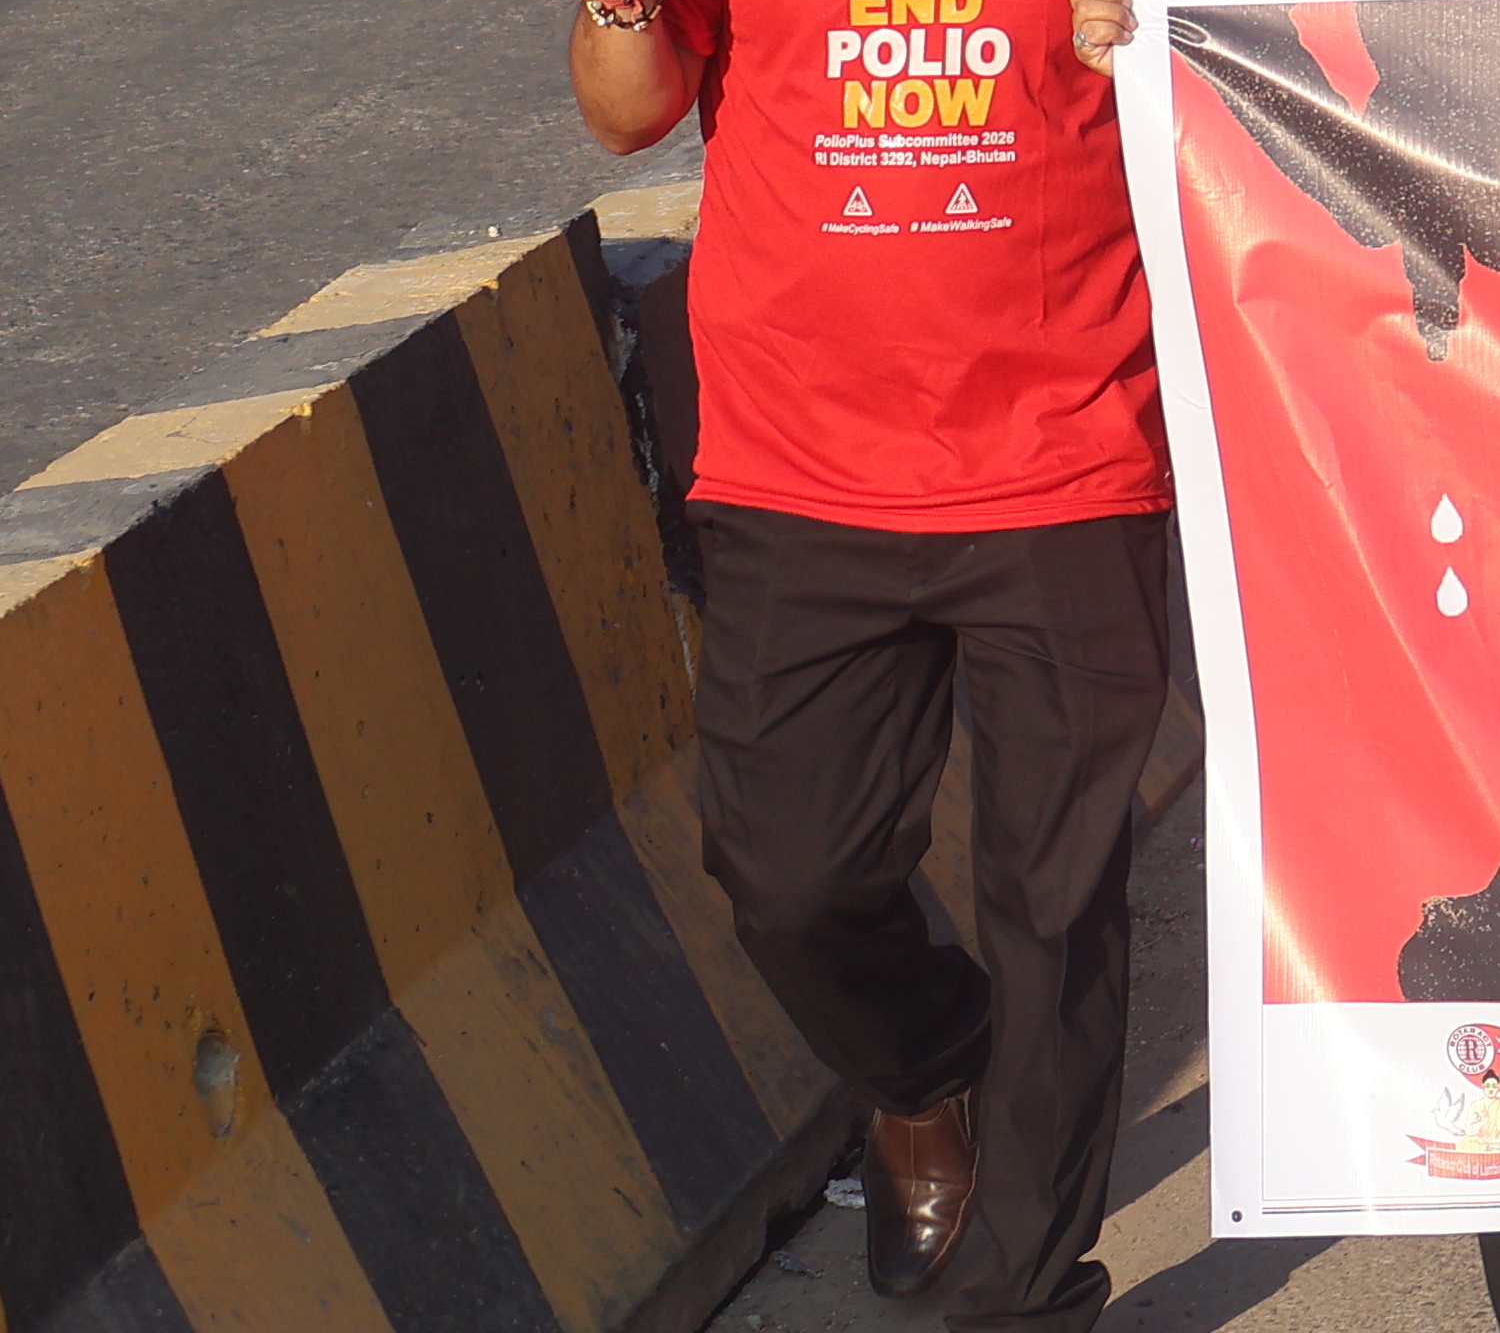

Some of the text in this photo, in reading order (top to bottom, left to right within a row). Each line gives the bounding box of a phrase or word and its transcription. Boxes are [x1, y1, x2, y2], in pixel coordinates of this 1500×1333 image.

[826, 29, 1011, 78] POLIO
[843, 79, 995, 128] NOW
[815, 132, 1015, 148] PolioPlus Subcommittee 2026
[815, 150, 1015, 167] RI District 3292, Nepal-Bhutan
